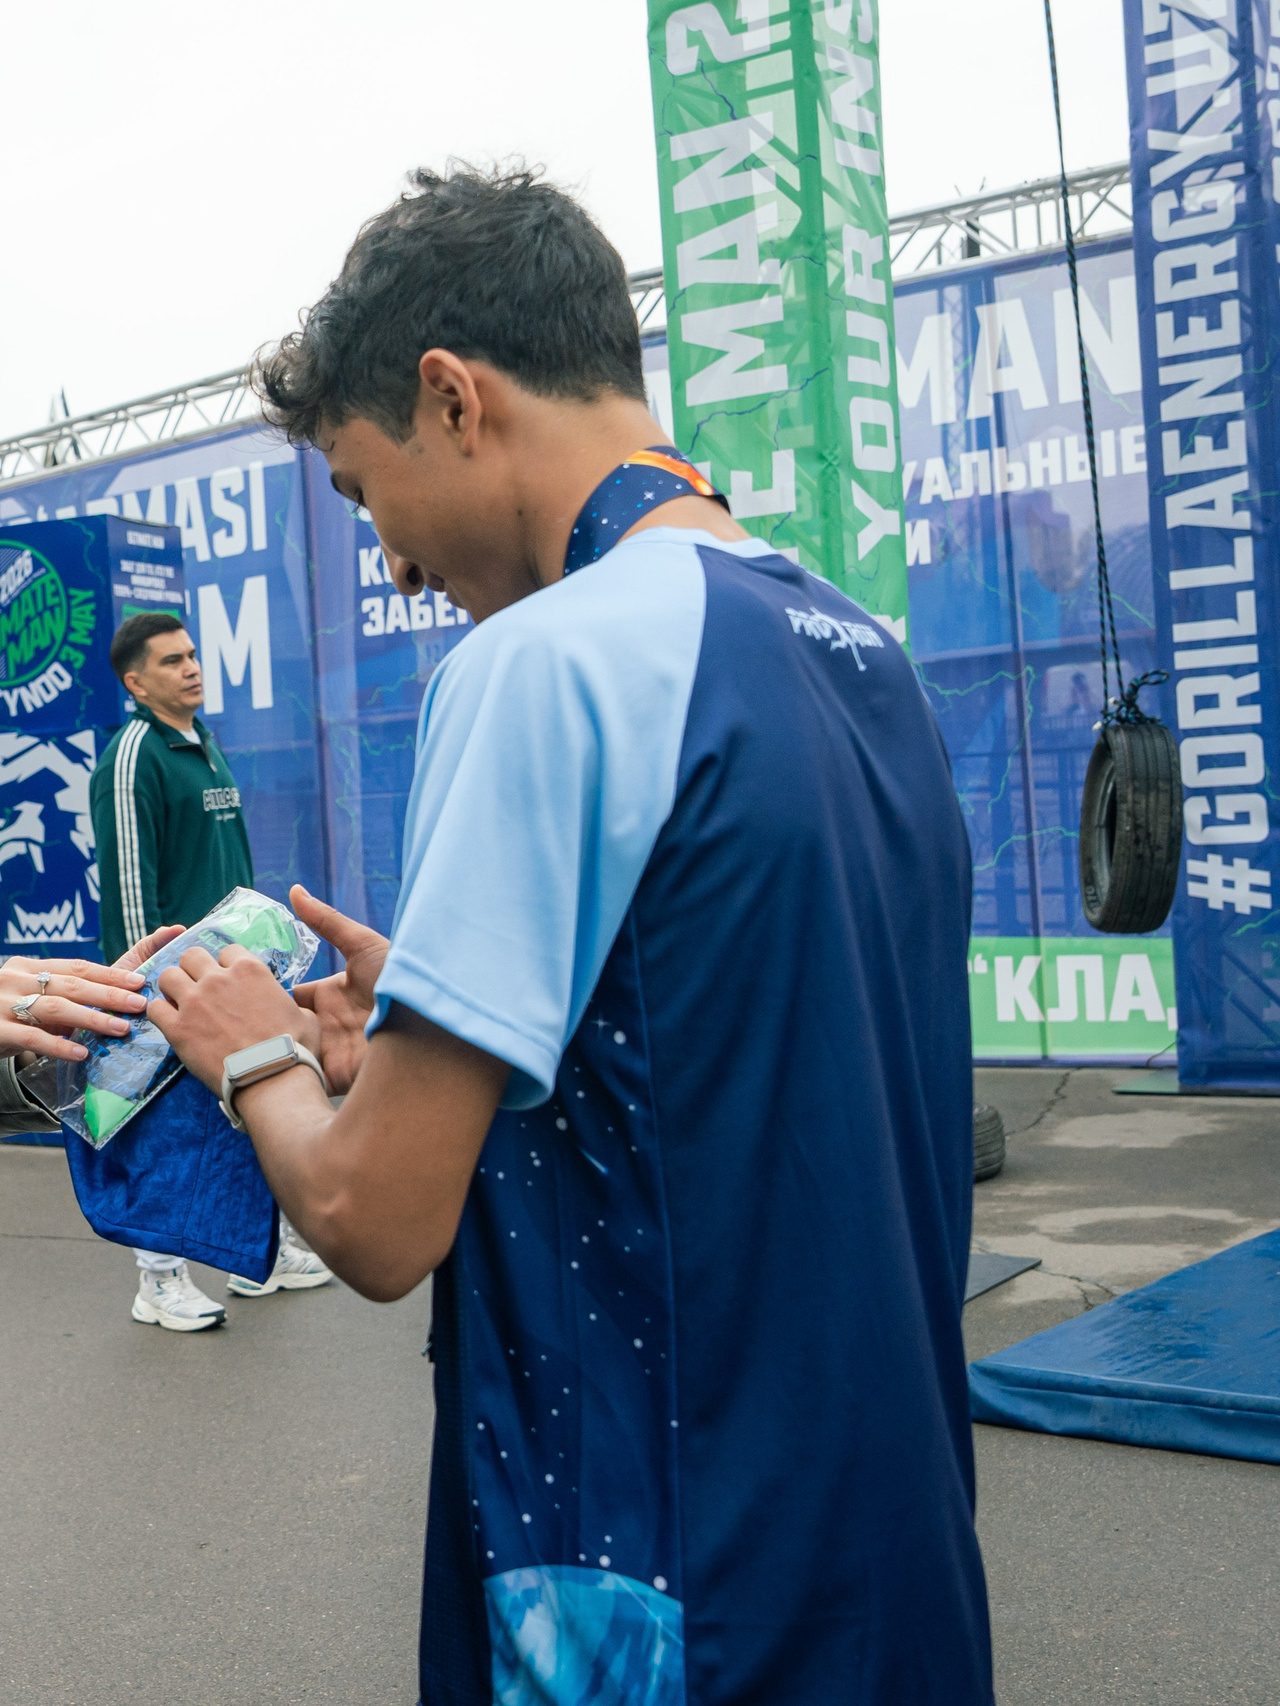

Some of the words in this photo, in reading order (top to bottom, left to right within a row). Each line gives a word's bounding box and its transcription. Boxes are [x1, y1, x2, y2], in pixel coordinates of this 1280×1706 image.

[670, 111, 788, 407] MAN
[840, 222, 903, 561] YOUR
[68, 586, 97, 646] MAY
[967, 952, 1179, 1032] “КЛА
